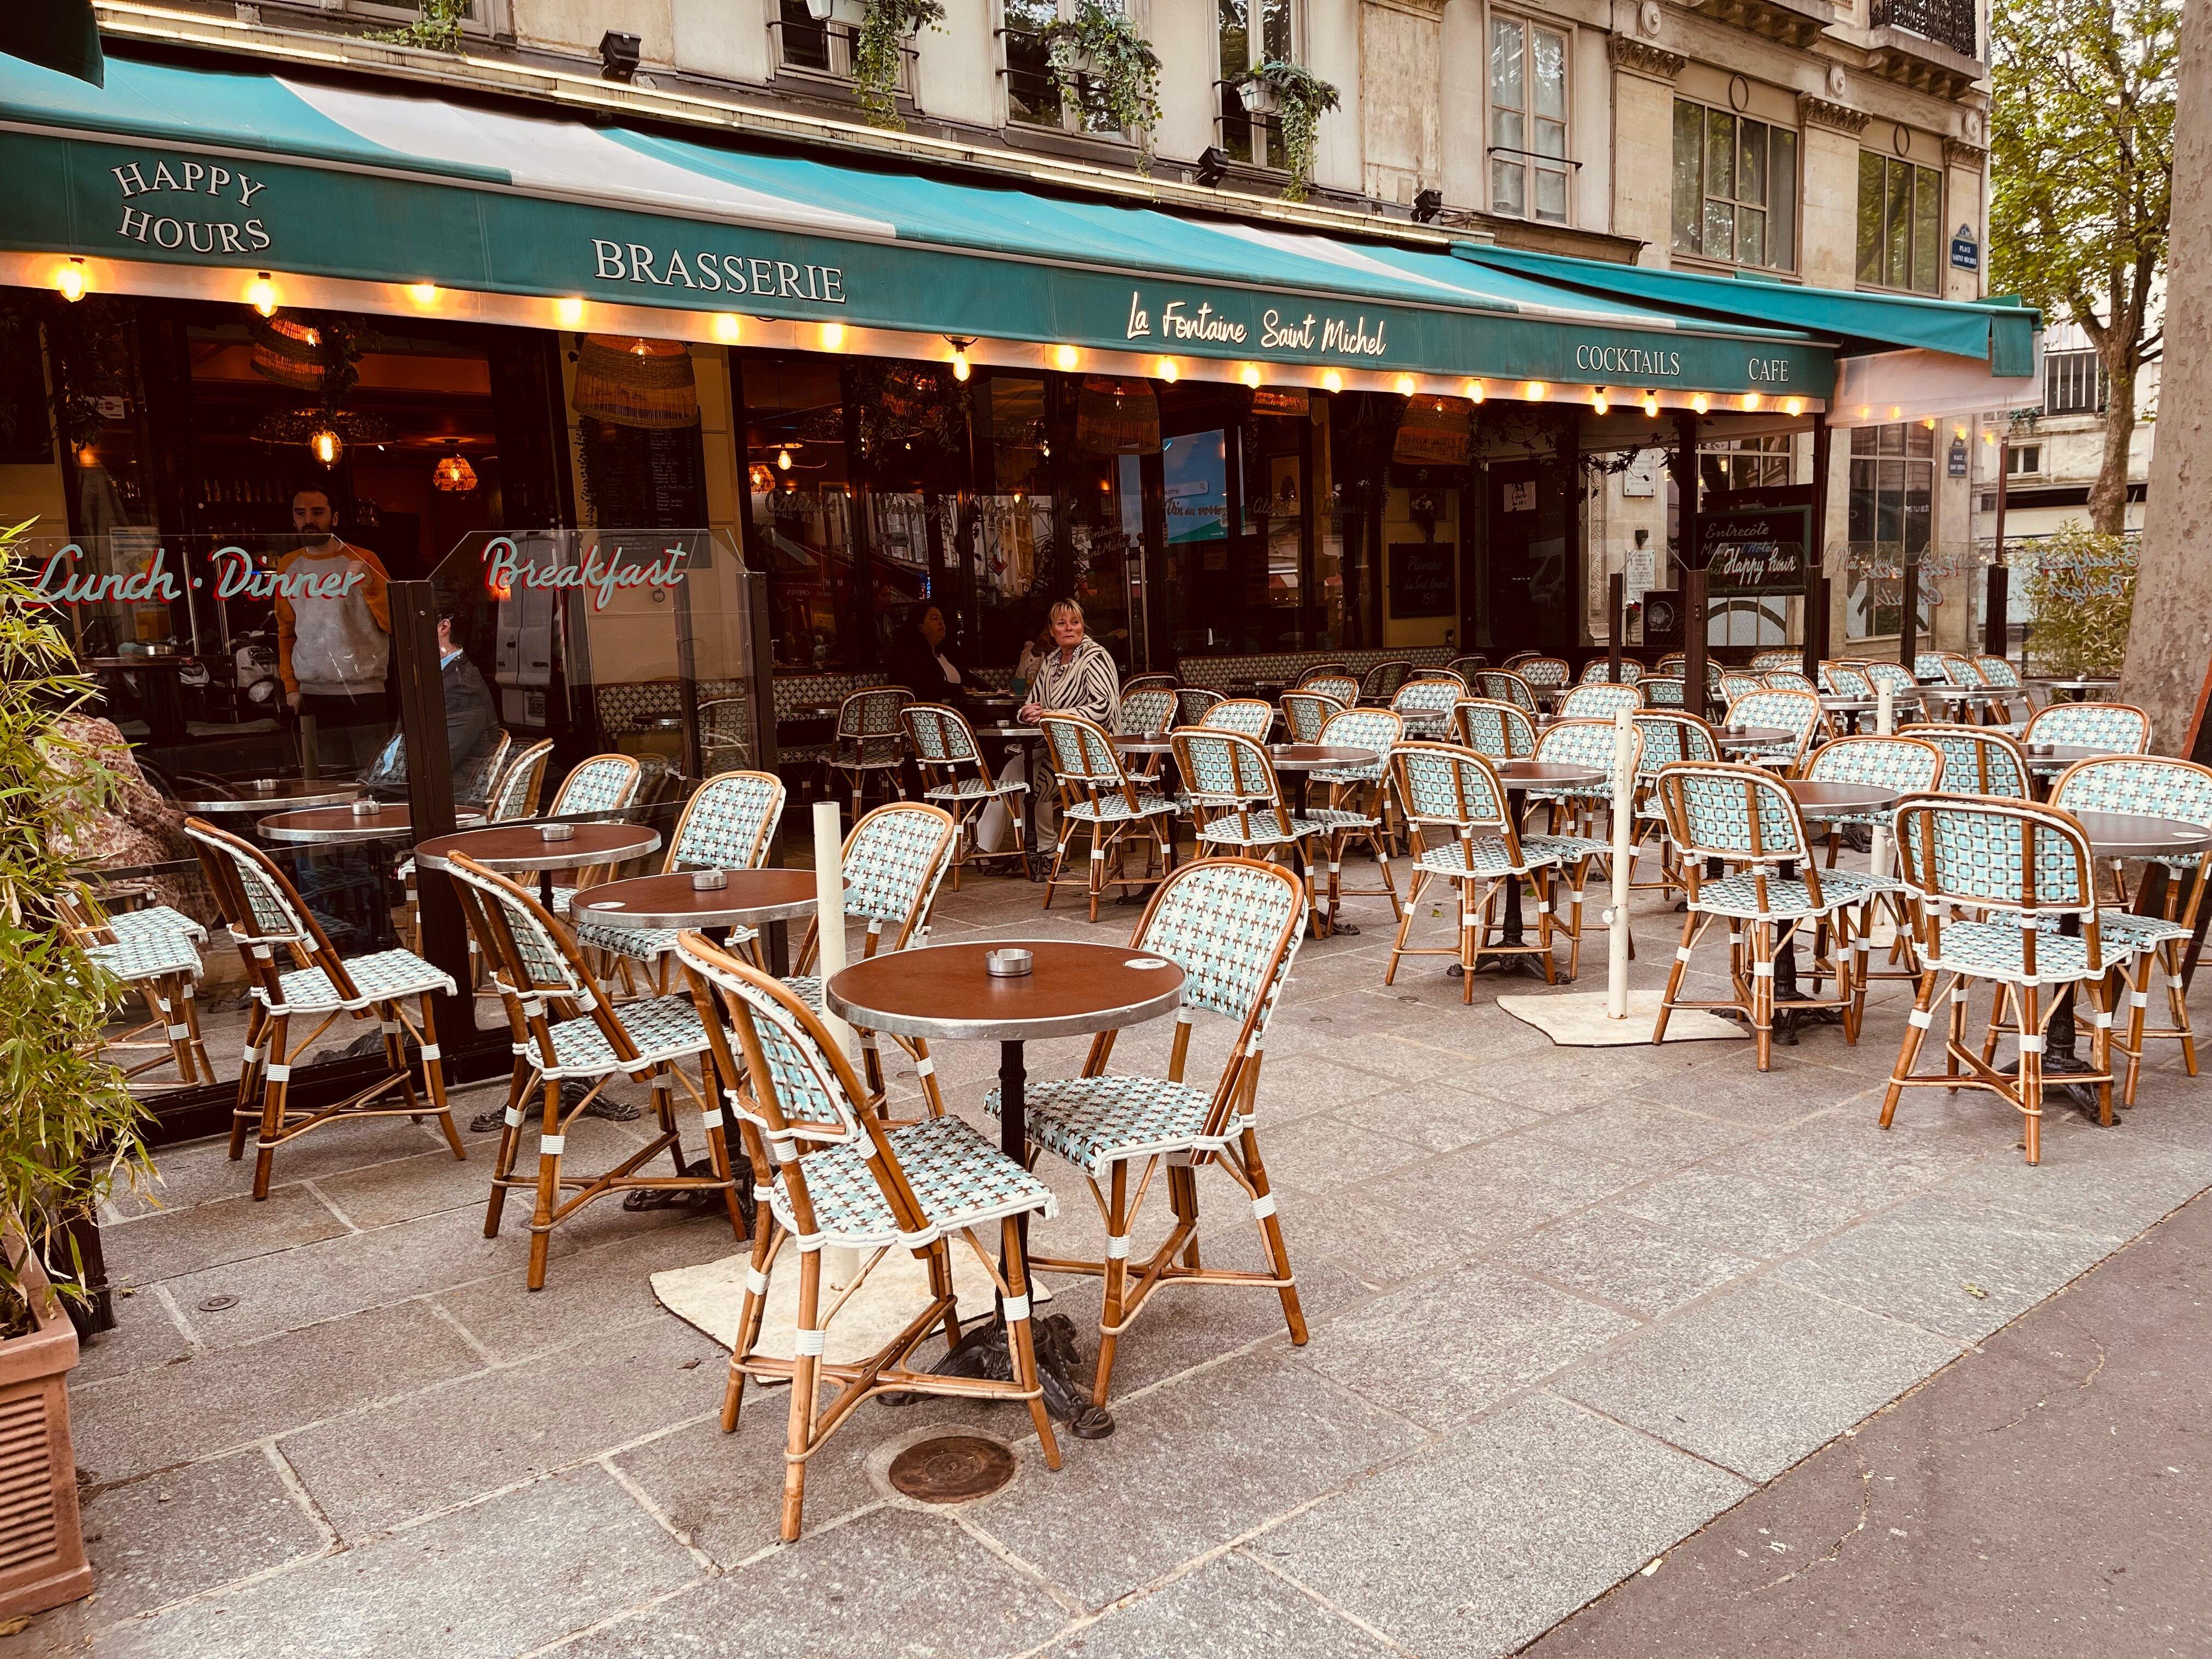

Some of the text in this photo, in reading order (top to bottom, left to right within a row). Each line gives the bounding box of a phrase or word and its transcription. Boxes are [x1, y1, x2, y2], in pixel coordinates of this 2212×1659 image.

[110, 159, 268, 208] HAPPY
[116, 204, 272, 253] HOURS
[590, 238, 847, 304] BRASSERIE
[1126, 291, 1387, 356] La Fontaine Saint Michel
[1576, 344, 1680, 376] COCKTAILS
[1748, 358, 1790, 382] CAFE
[1705, 521, 1769, 539] Entrecôte
[23, 544, 366, 607] Lunch Dinner
[483, 537, 687, 612] Breakfast
[1723, 547, 1764, 585] Happy
[1768, 547, 1796, 572] hour
[1837, 545, 1860, 572] Plat
